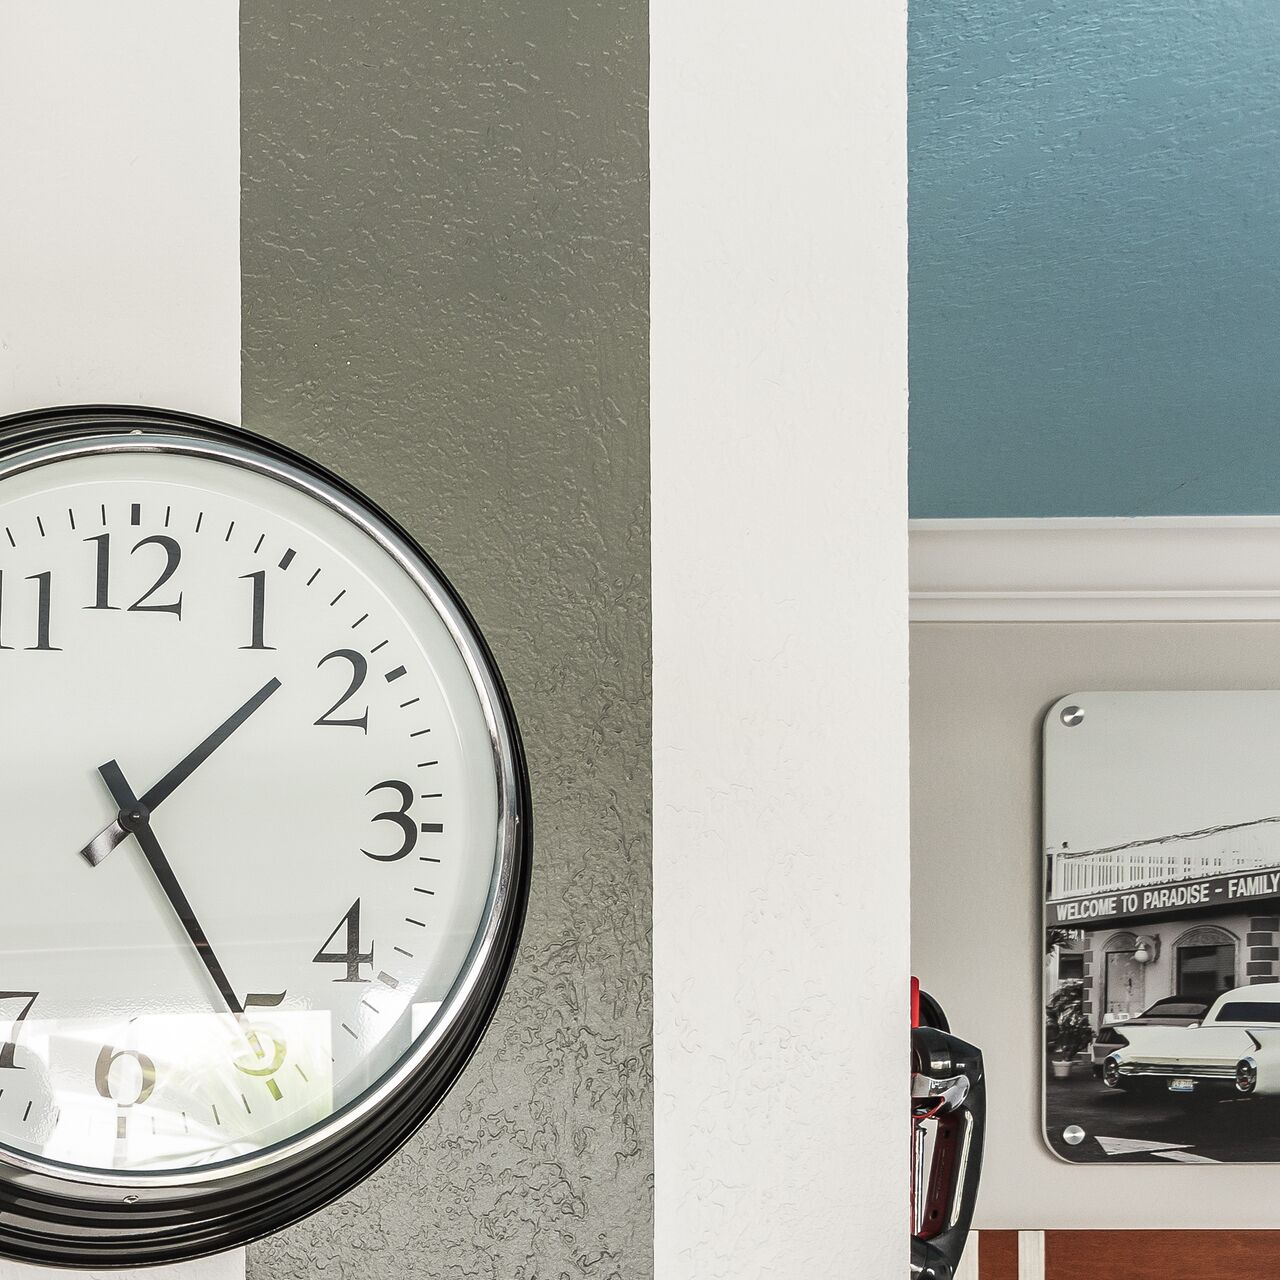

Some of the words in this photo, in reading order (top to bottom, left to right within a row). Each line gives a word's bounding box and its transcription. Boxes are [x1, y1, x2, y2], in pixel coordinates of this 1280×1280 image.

[83, 532, 183, 622] 12
[238, 569, 277, 651] 1
[314, 649, 370, 735] 2
[360, 780, 417, 862] 3
[313, 897, 374, 983] 4
[1057, 897, 1117, 921] WELCOME
[1121, 894, 1139, 913] TO
[1143, 883, 1210, 909] PARADISE
[1228, 873, 1280, 899] FAMILY
[95, 1018, 157, 1108] 6
